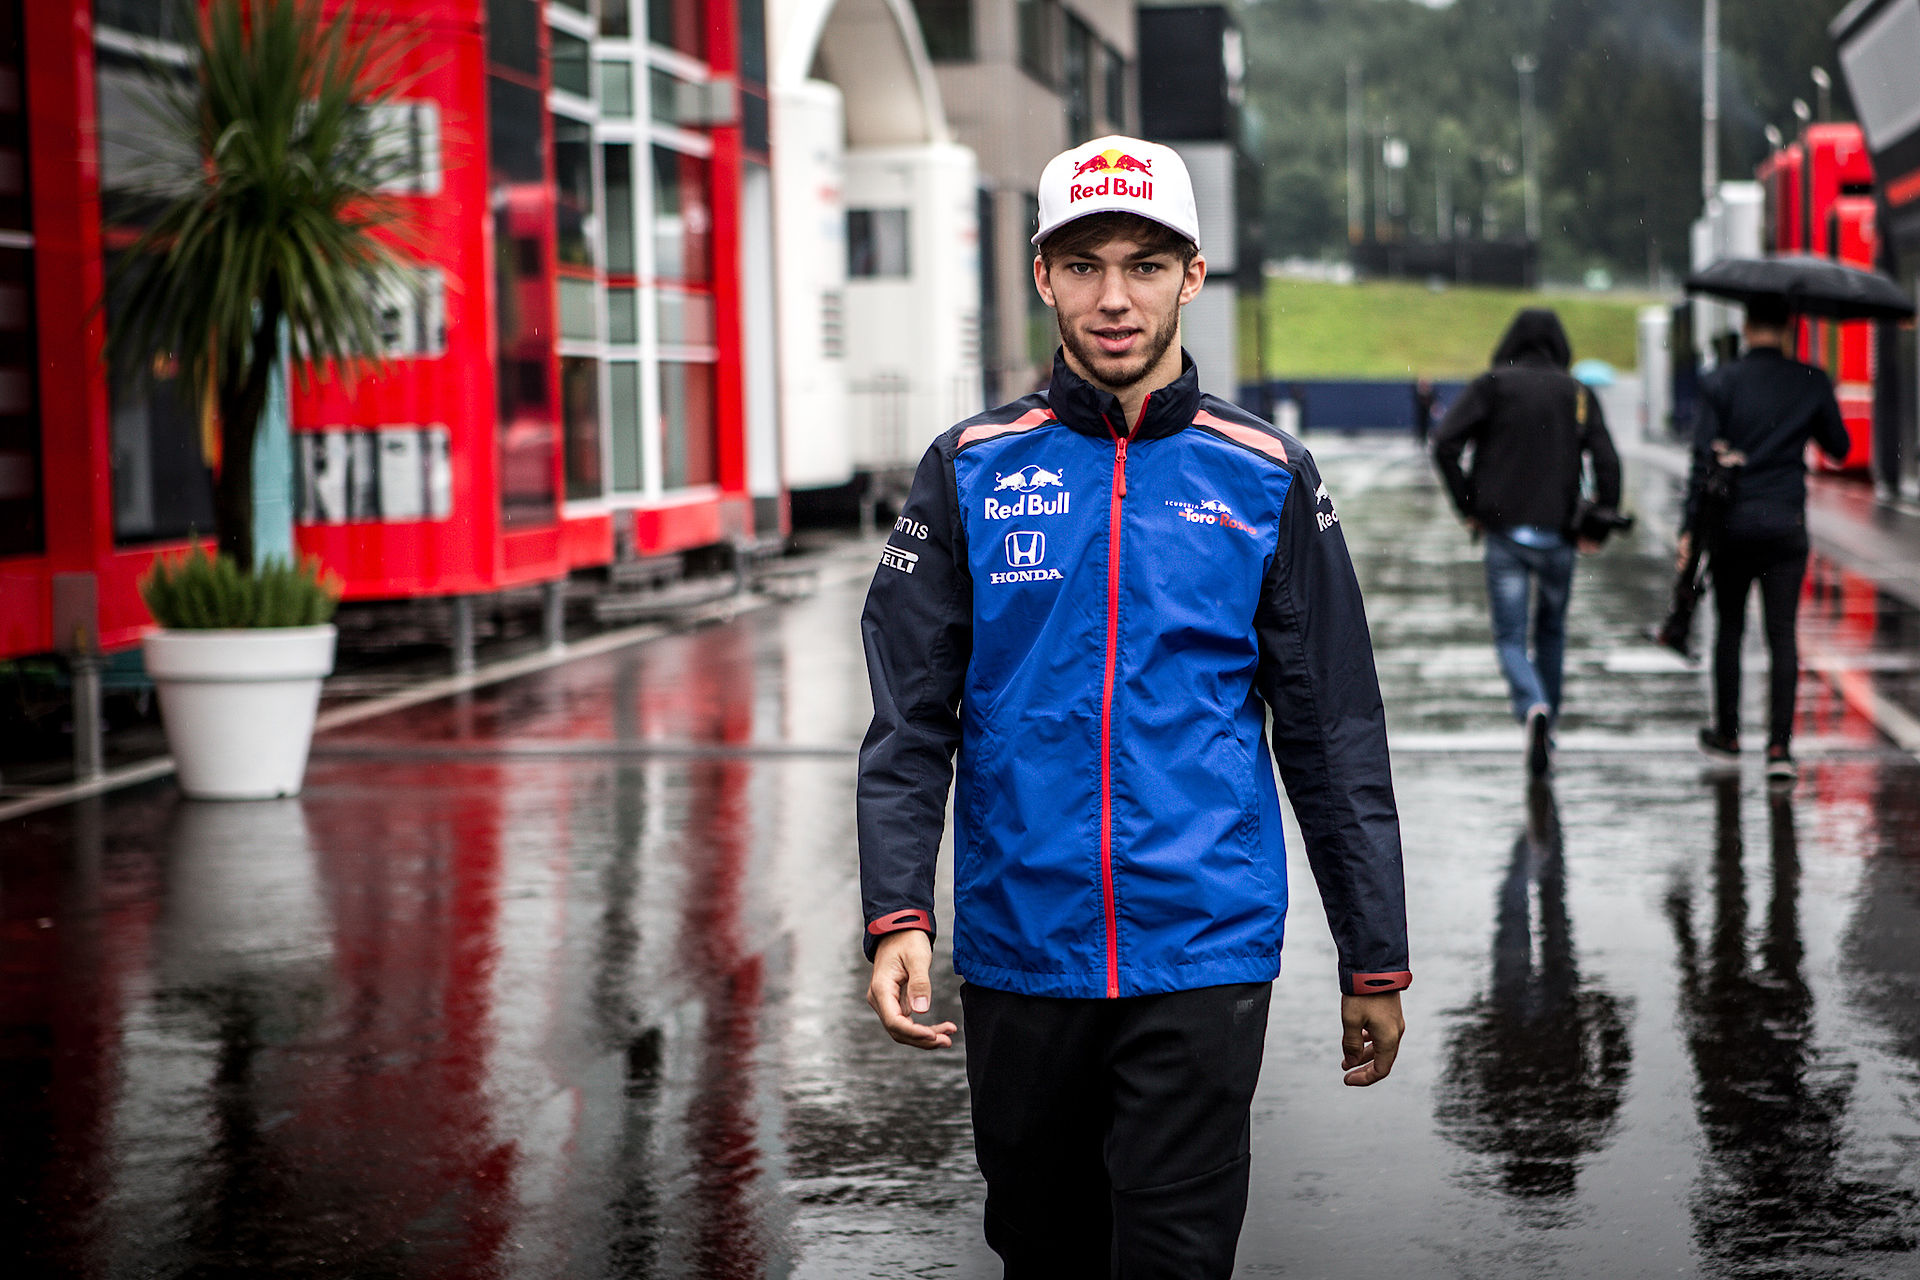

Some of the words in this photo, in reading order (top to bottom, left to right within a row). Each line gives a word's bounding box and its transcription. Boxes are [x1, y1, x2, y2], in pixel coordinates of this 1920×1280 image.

[1070, 177, 1109, 203] Red
[1113, 178, 1153, 200] Bull
[984, 494, 1025, 520] Red
[1027, 491, 1071, 516] Bull
[1184, 507, 1216, 524] Toro
[880, 552, 916, 574] ELLI
[989, 568, 1064, 585] HONDA
